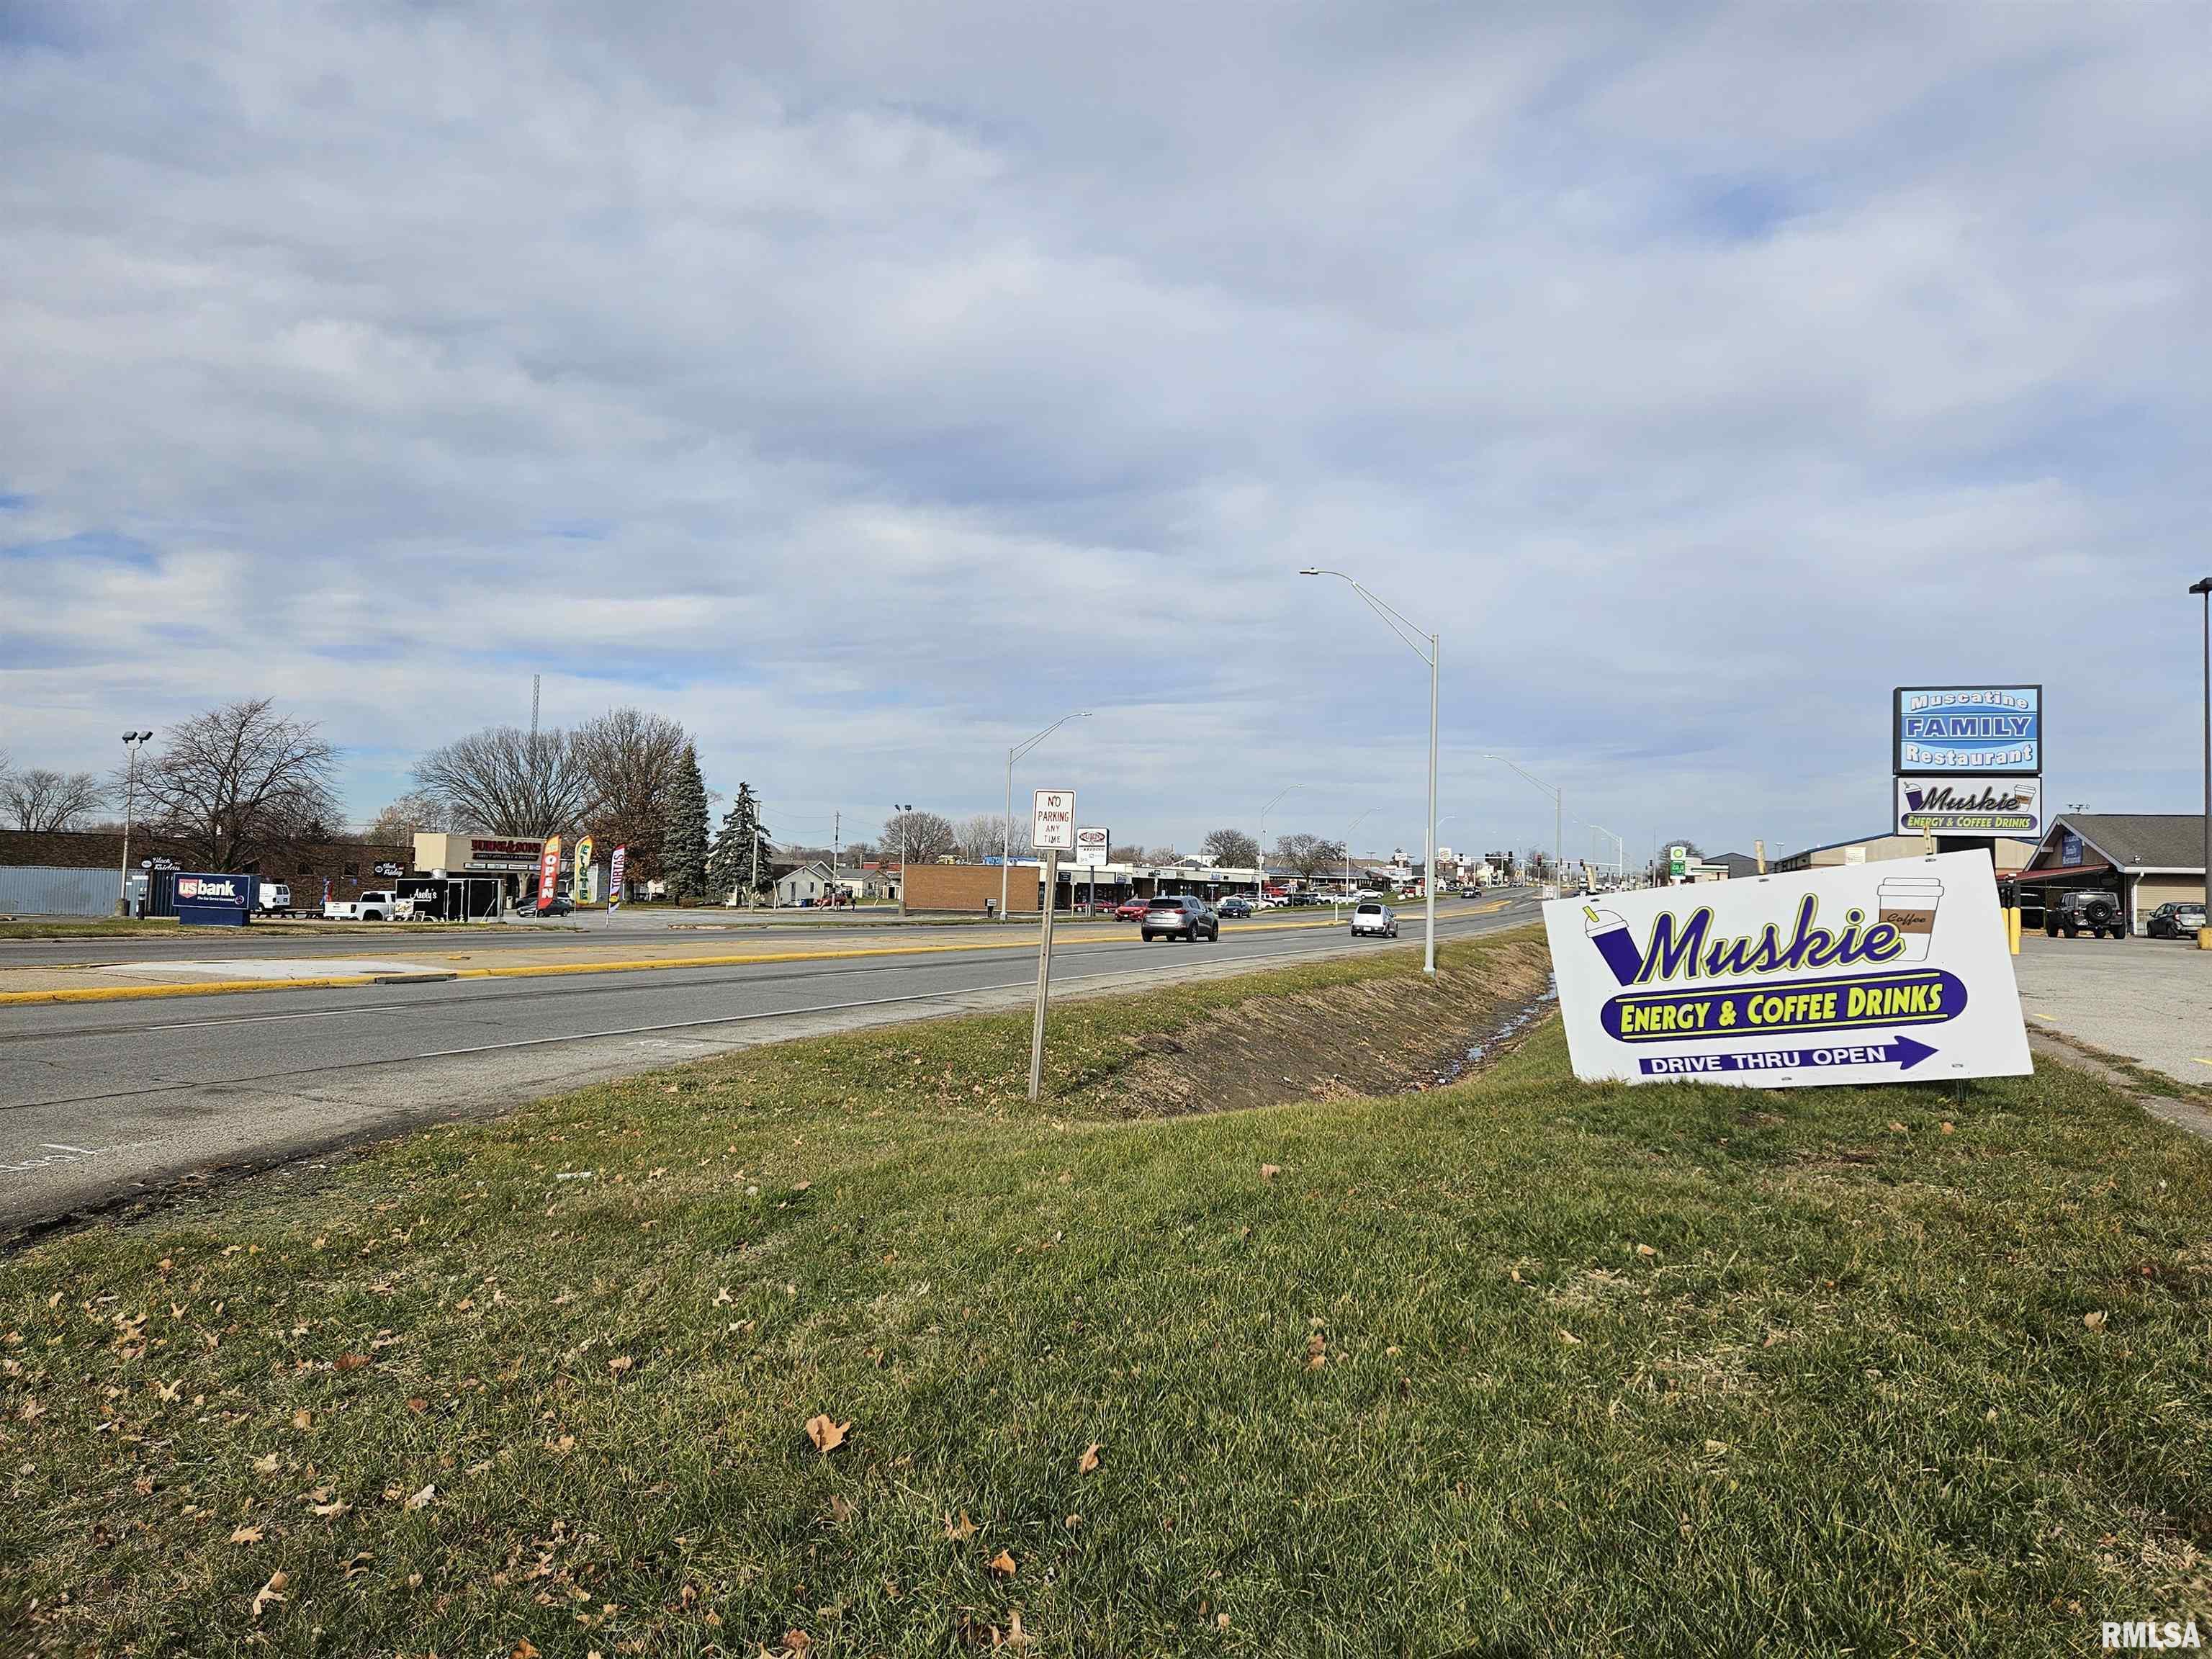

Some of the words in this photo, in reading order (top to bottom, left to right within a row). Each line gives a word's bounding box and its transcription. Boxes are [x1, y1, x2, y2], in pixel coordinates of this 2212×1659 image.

[1910, 691, 2029, 711] Muscatine
[1906, 717, 2033, 737] FAMILY
[1906, 743, 2033, 767] Restaurant
[1048, 796, 1061, 807] NO
[1918, 786, 2019, 812] Muskie
[1038, 811, 1069, 822] PARKING
[1907, 816, 1944, 827] ENERGY
[1946, 817, 1954, 827] &
[1956, 816, 1993, 827] COFFEE
[1995, 817, 2031, 828] DRINKS
[1044, 835, 1061, 844] TIME
[541, 855, 557, 899] OPEN
[1887, 913, 1926, 926] Coffee
[1633, 893, 1907, 984] Muskie
[1620, 1000, 1710, 1033] ENERGY
[1719, 1000, 1737, 1027] &
[1748, 992, 1838, 1025] COFFEE
[1847, 983, 1943, 1018] DRINKS
[1650, 1055, 1723, 1074] DRIVE
[1731, 1051, 1800, 1069] THRU
[1812, 1046, 1887, 1065] OPEN
